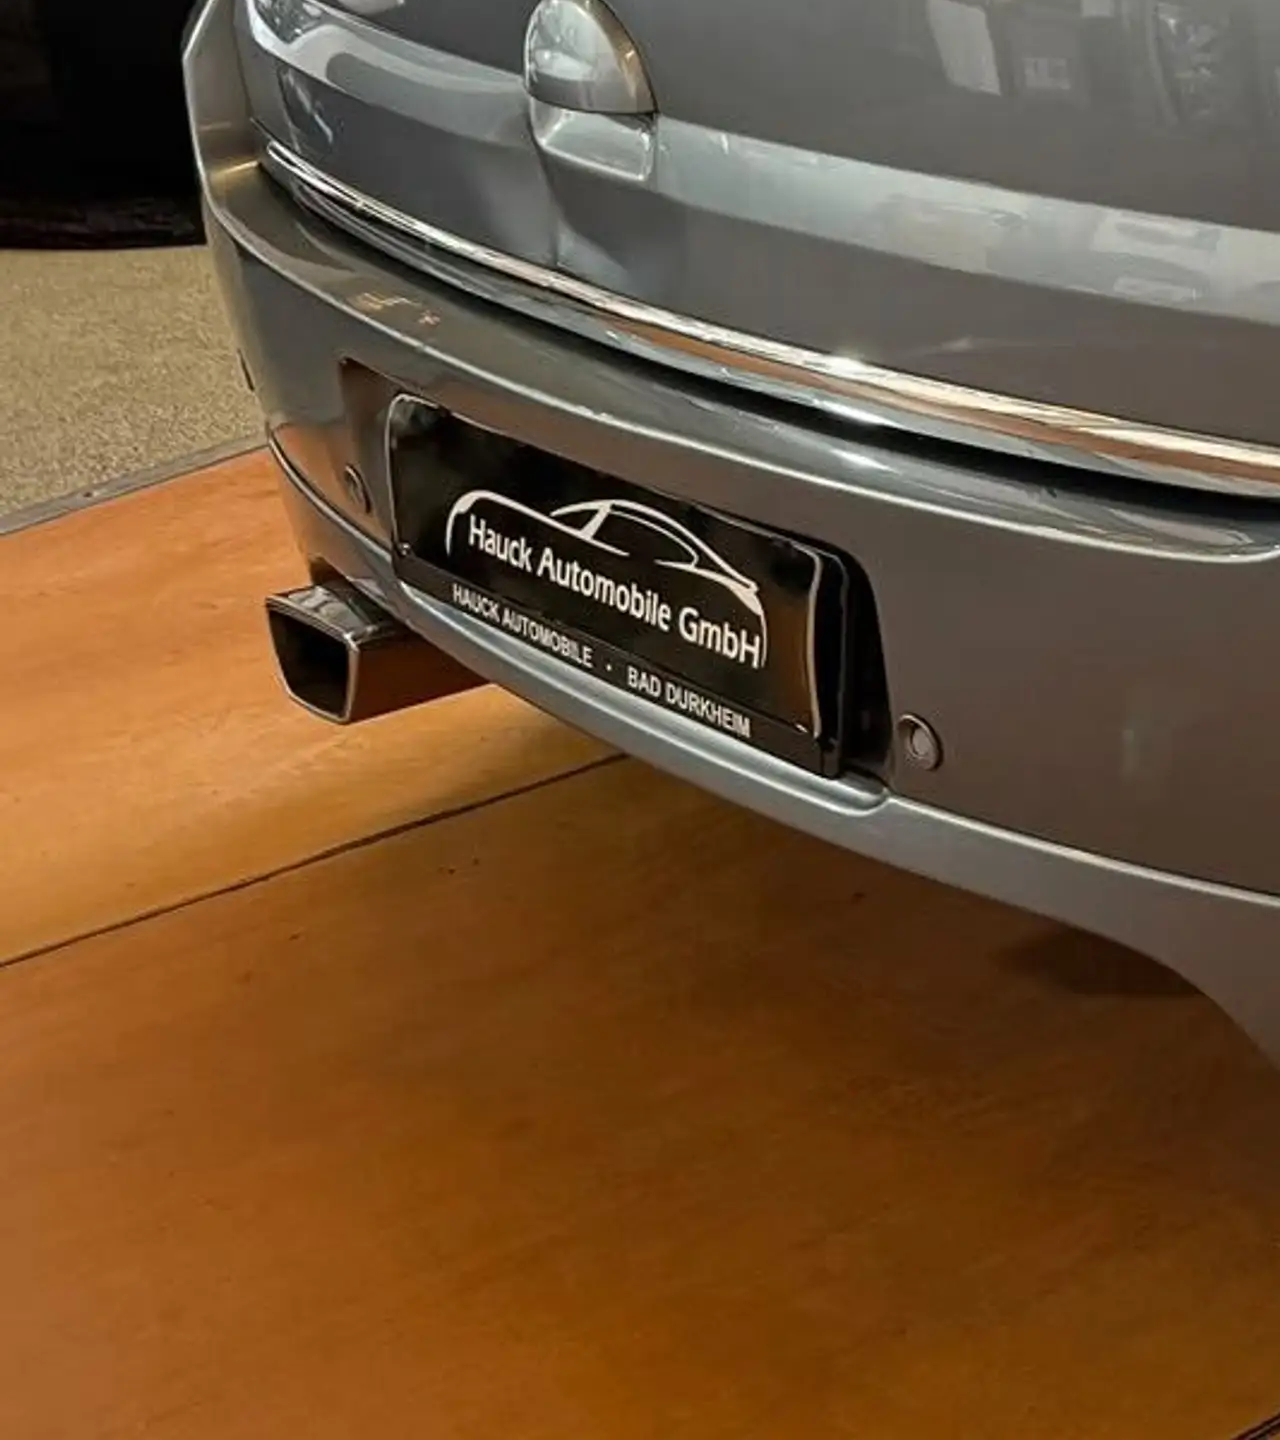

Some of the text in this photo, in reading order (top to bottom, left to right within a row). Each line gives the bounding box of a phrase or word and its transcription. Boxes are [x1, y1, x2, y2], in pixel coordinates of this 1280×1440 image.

[452, 583, 500, 622] HAUCK
[500, 608, 593, 668] AUTOMOBILE
[627, 665, 662, 697] BAD
[468, 515, 760, 669] Hauck Automobile GmbH
